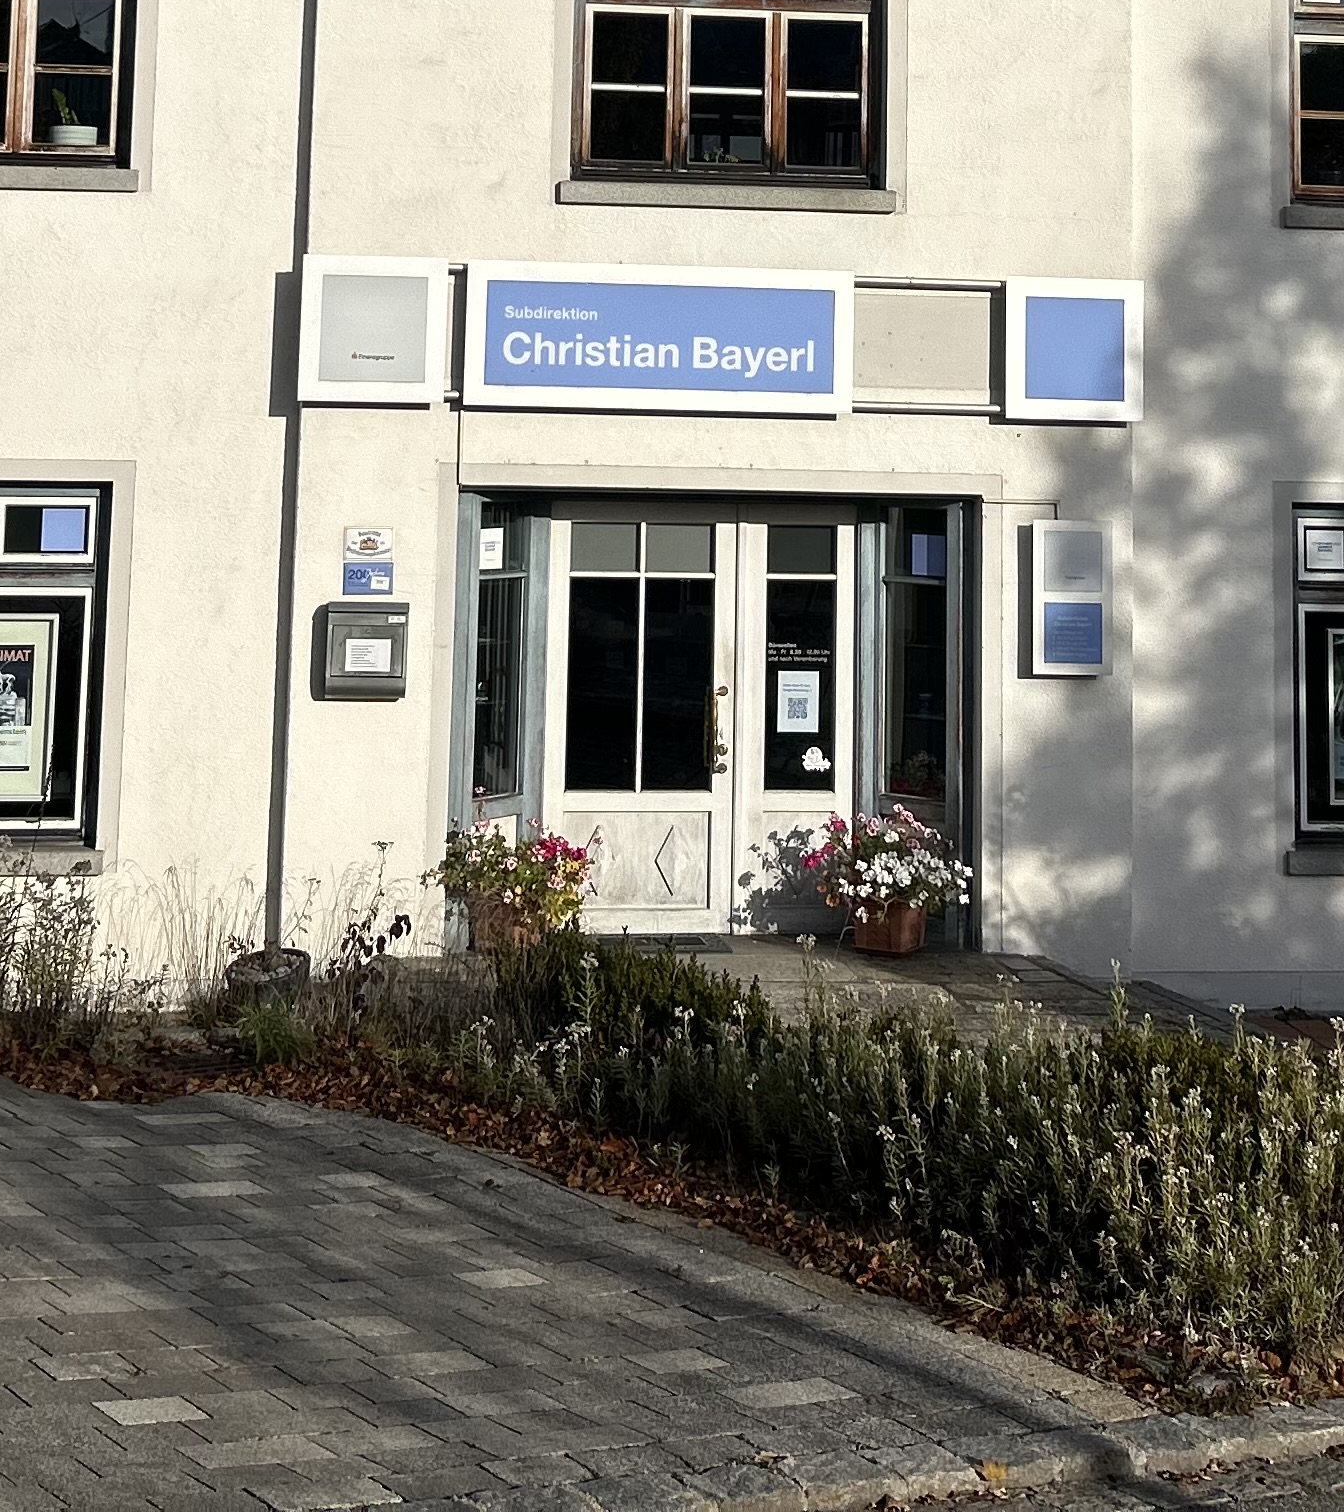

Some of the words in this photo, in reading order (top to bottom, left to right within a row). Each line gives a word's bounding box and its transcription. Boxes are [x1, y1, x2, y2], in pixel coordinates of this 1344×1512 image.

[504, 305, 598, 321] Subdirektion
[503, 332, 680, 369] Christian
[692, 336, 815, 378] Bayerl
